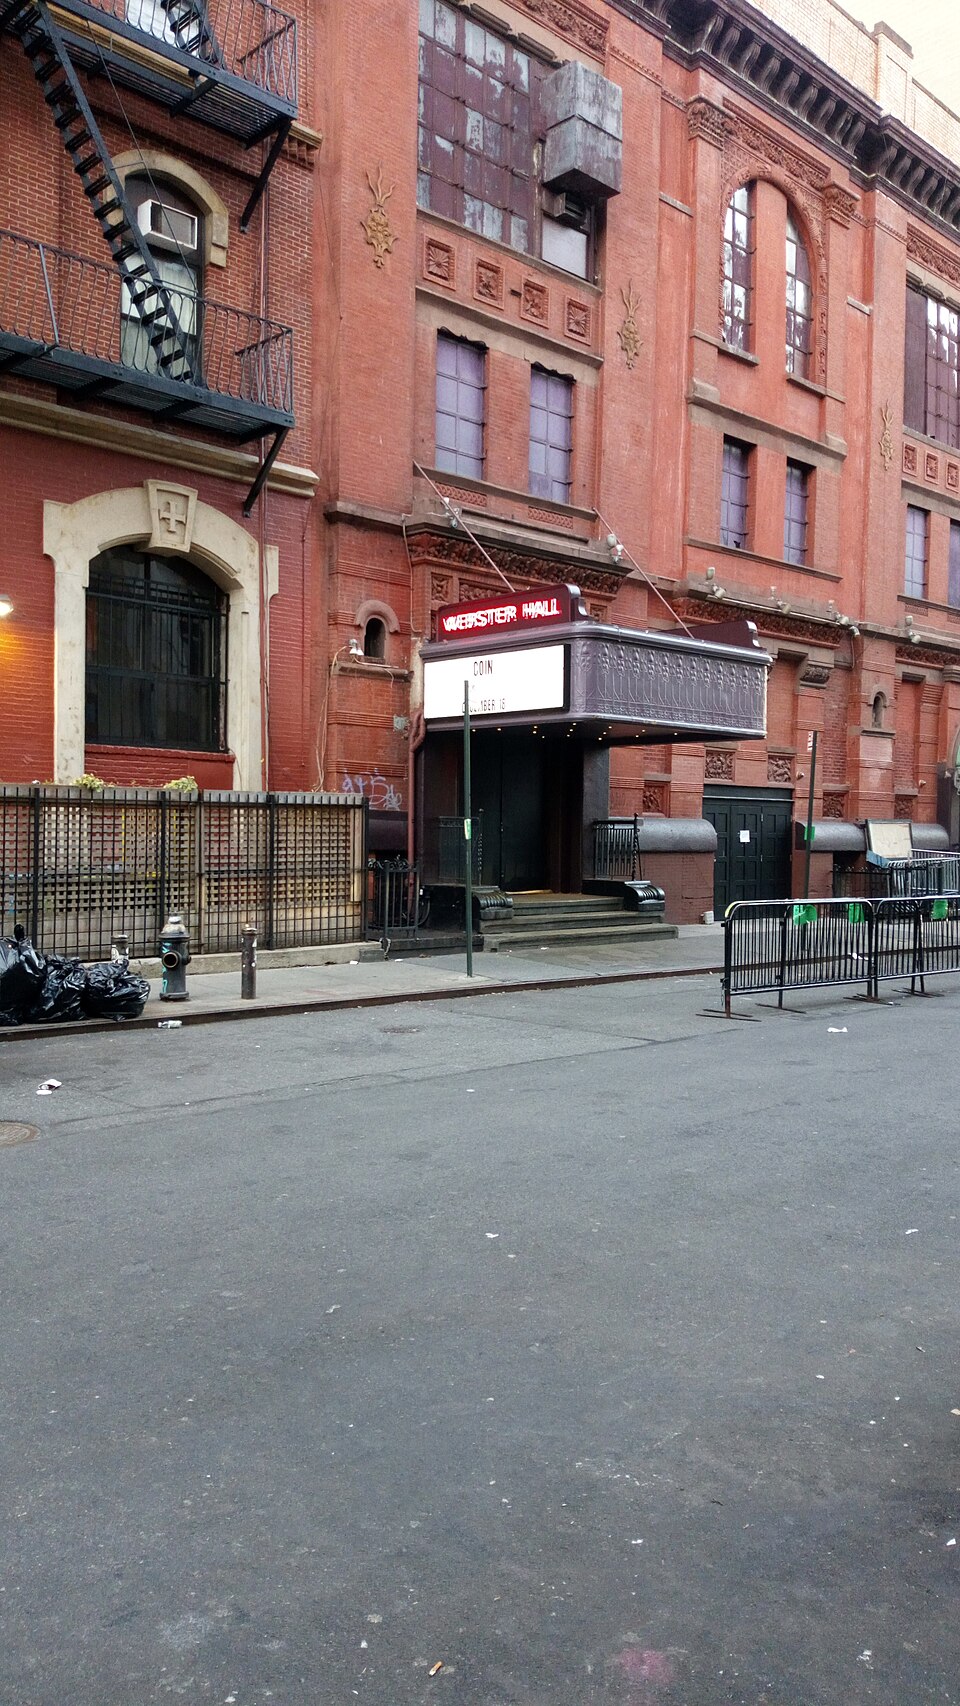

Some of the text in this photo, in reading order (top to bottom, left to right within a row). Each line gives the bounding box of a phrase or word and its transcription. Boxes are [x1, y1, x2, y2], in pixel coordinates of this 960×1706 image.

[443, 598, 561, 631] WEBSTER HALL
[473, 660, 493, 676] COIN
